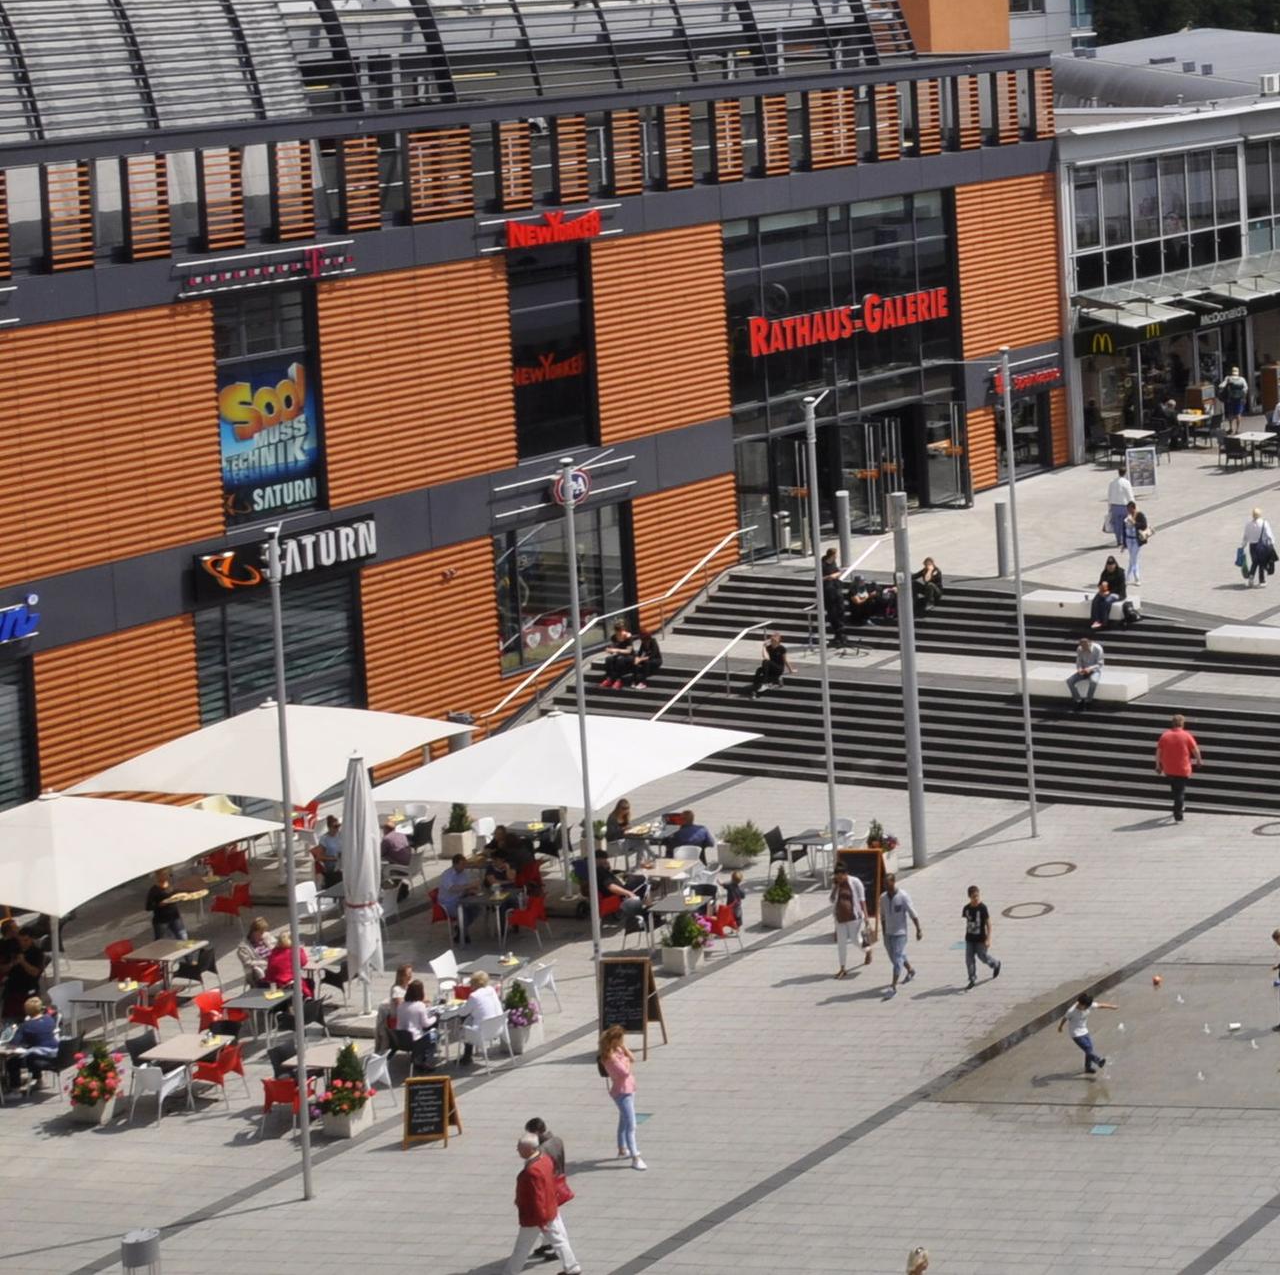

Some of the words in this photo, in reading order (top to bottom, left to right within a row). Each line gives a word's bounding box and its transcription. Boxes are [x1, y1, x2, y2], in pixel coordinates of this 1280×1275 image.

[749, 286, 949, 358] RATHAUS-GALERIE
[222, 436, 308, 471] TECHNIK
[253, 477, 317, 512] SATURN
